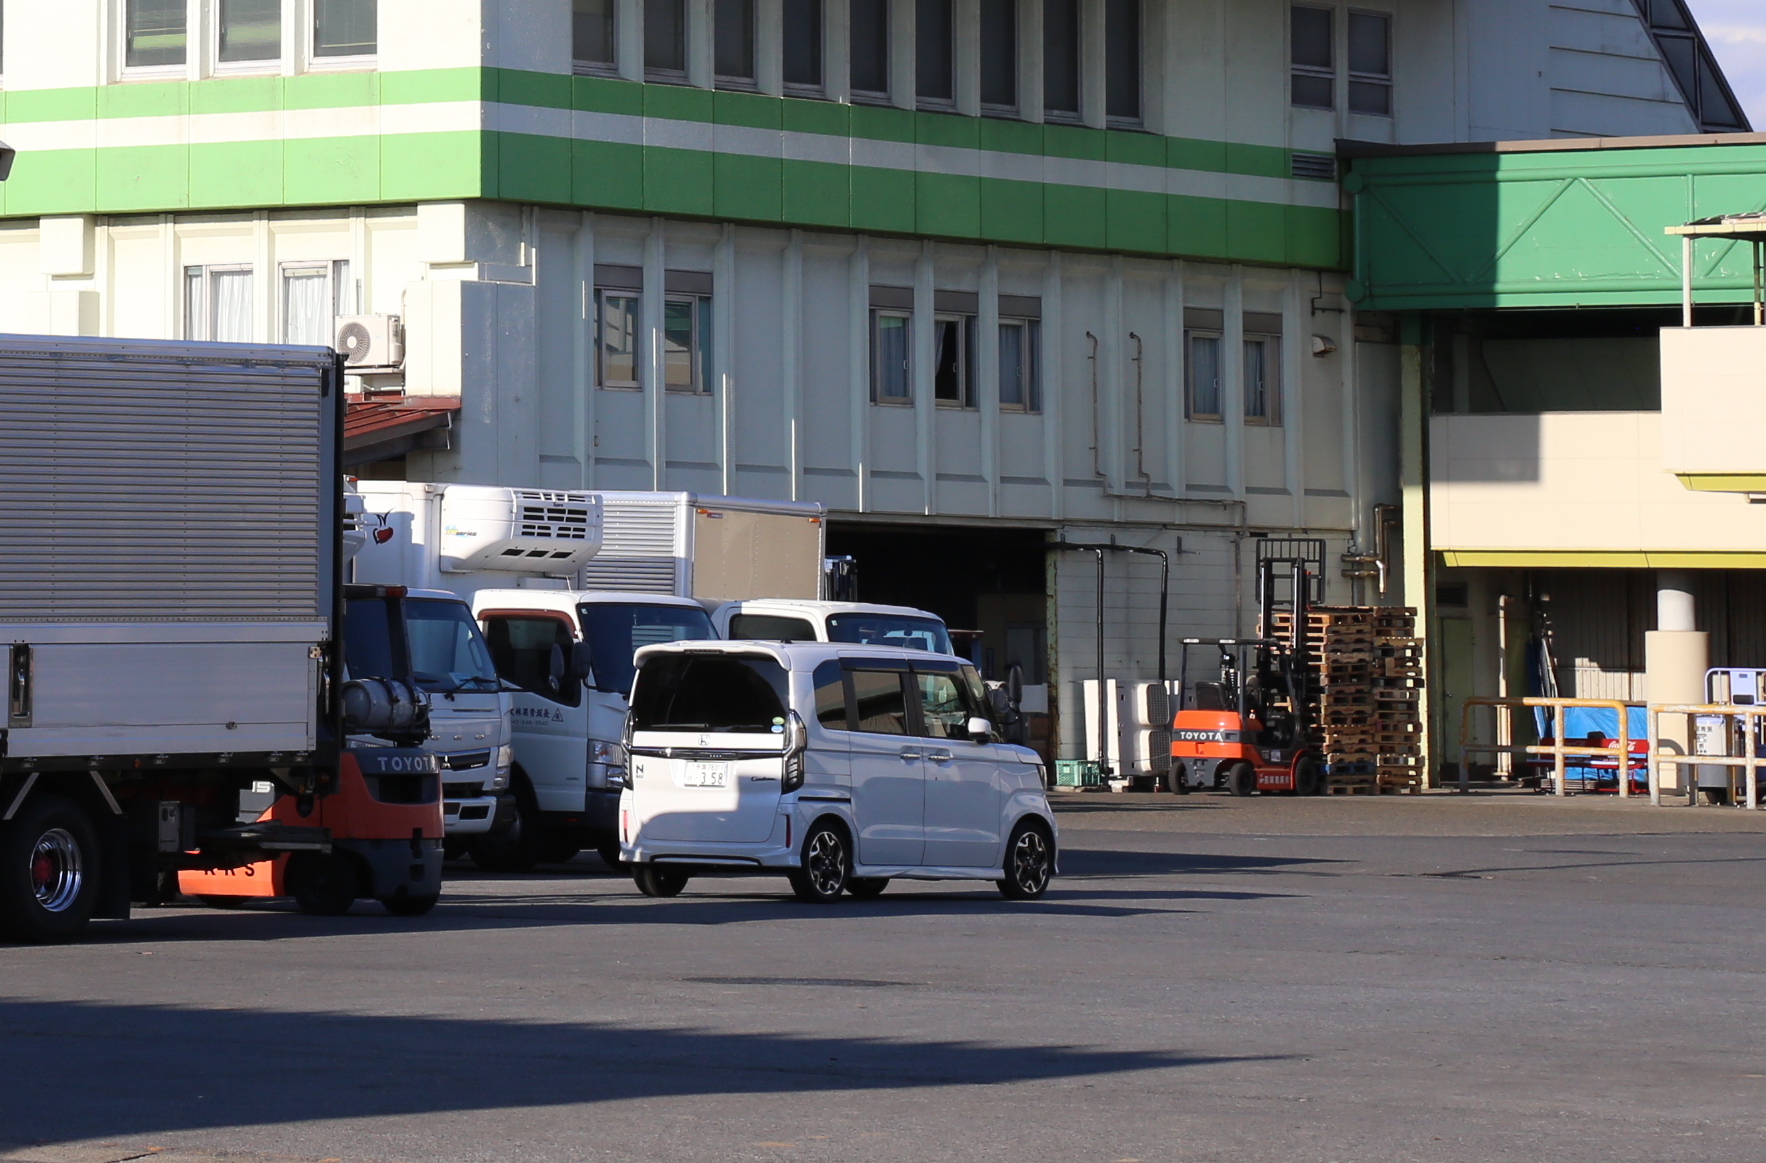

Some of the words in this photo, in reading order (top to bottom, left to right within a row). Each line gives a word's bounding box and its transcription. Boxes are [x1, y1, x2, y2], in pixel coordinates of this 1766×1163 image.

[1180, 731, 1223, 741] TOYOTA
[377, 755, 436, 771] TOYOTA
[636, 764, 644, 774] N
